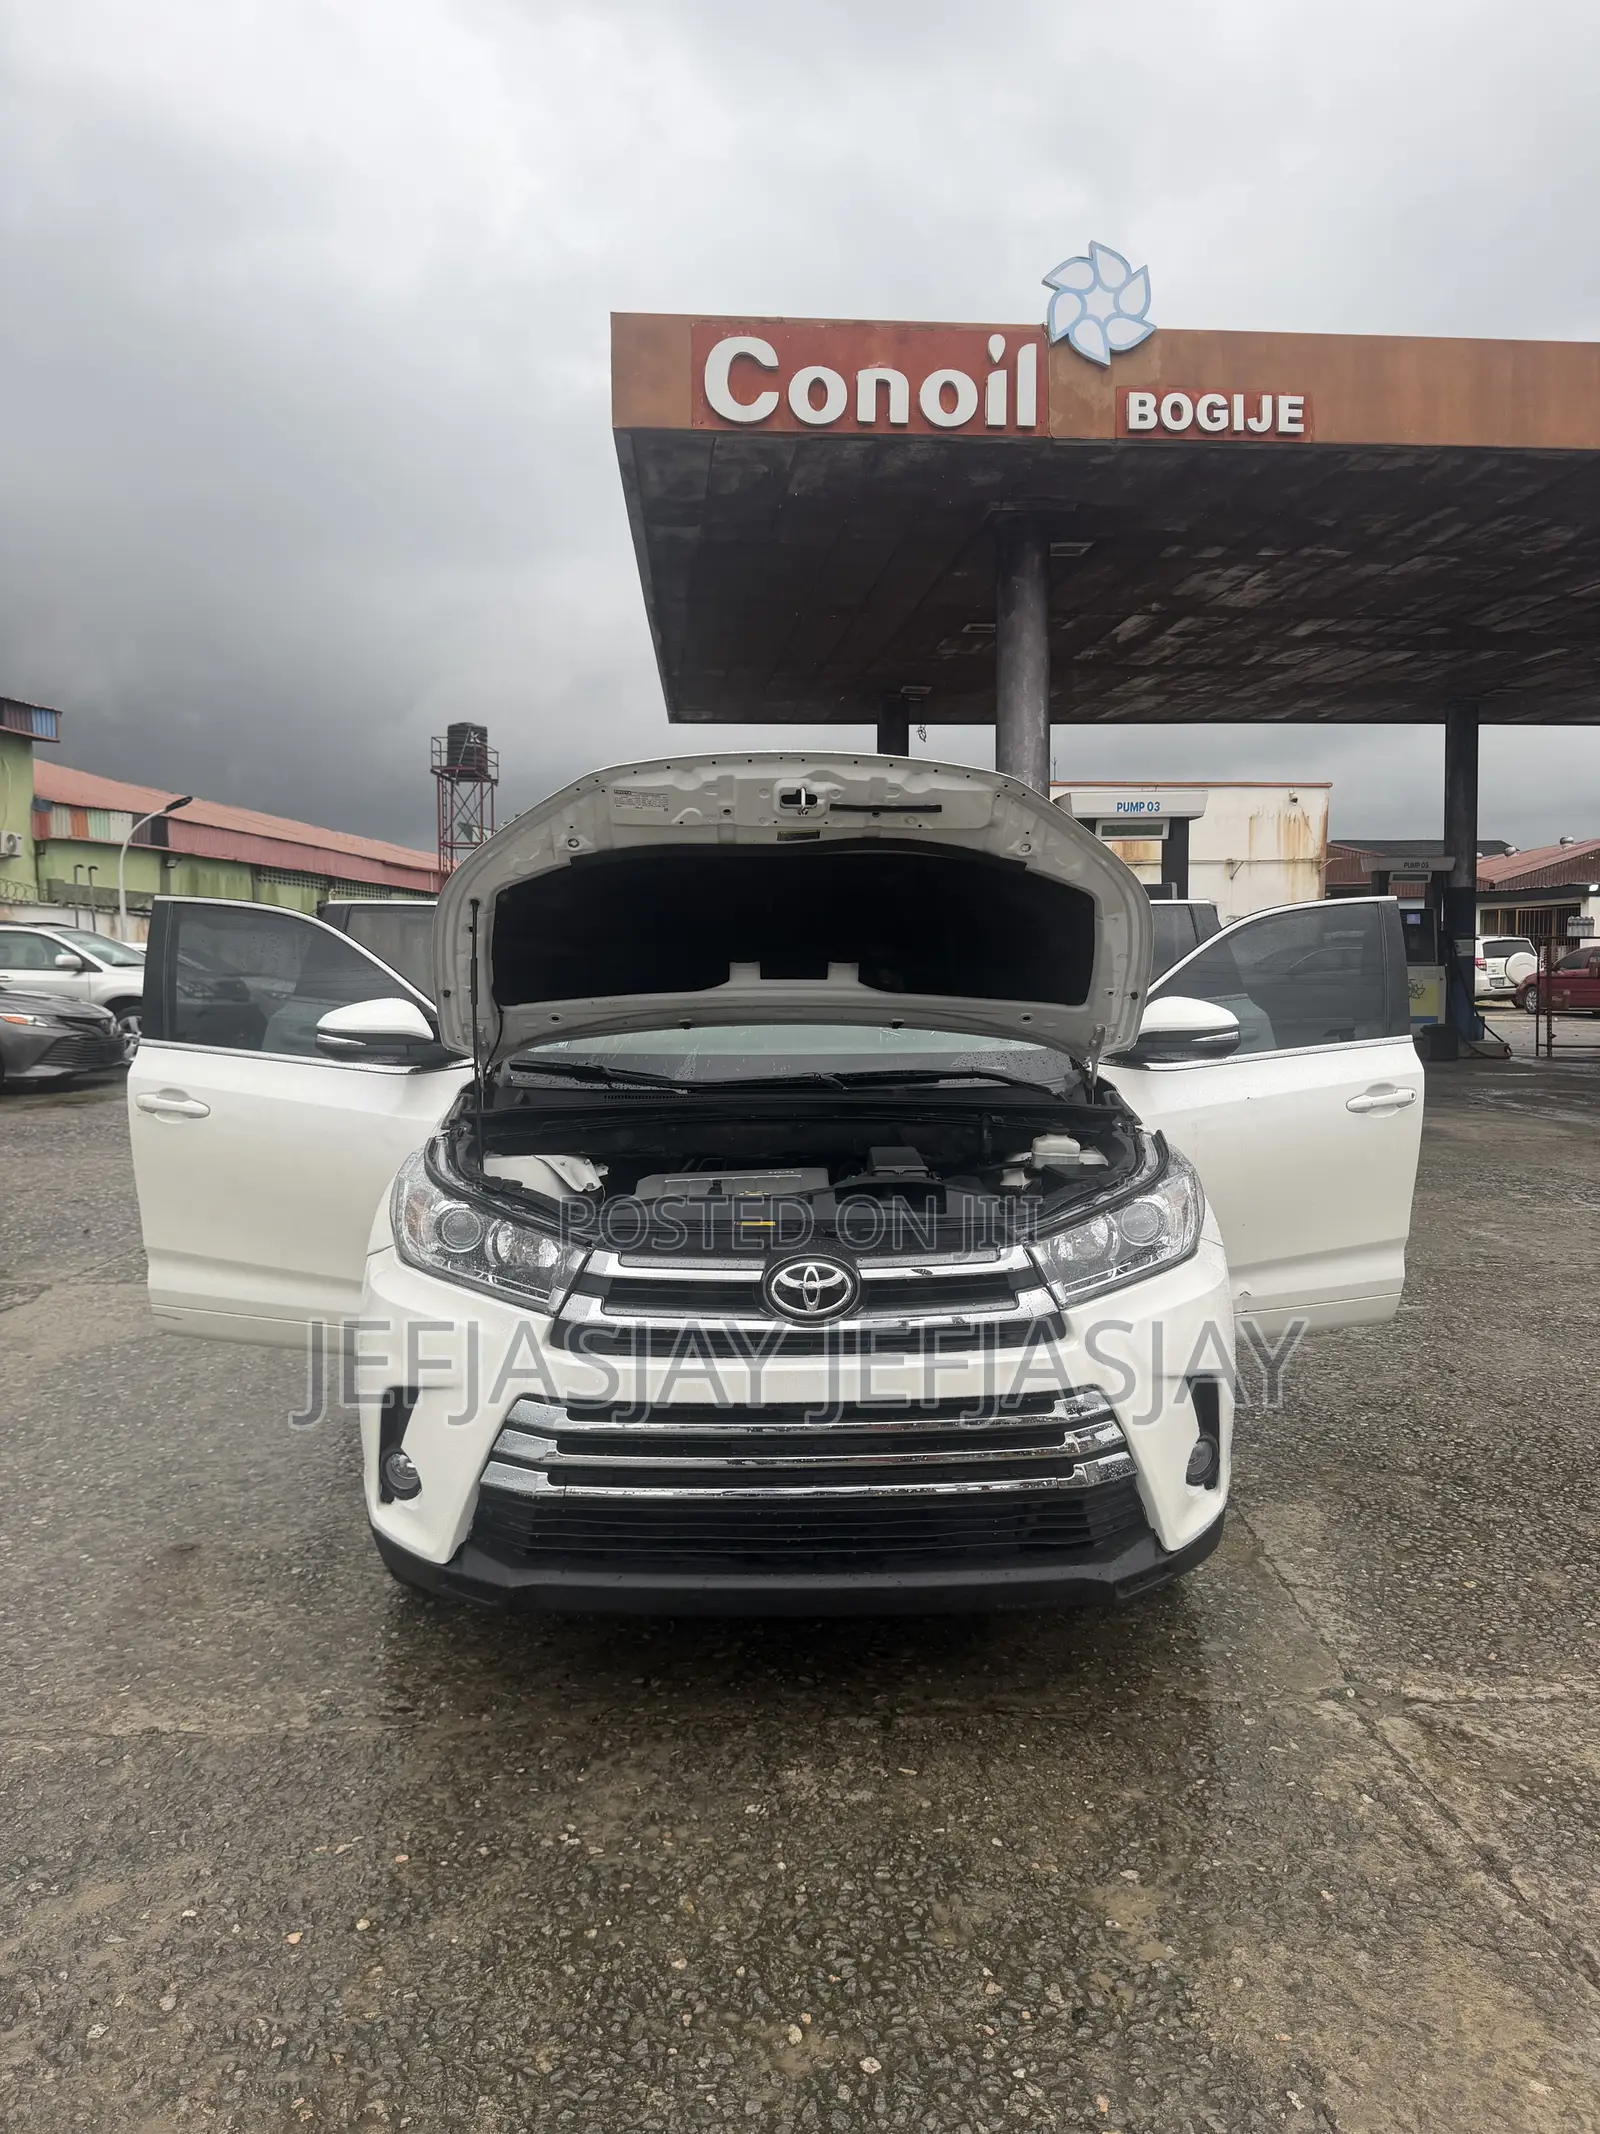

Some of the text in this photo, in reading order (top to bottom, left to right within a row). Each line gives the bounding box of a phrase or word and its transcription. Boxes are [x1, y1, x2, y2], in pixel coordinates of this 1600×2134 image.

[704, 333, 1037, 427] Conoil
[1127, 392, 1305, 434] BOGIJE
[1116, 801, 1160, 812] PUMP 03
[1403, 861, 1420, 869] PUMP
